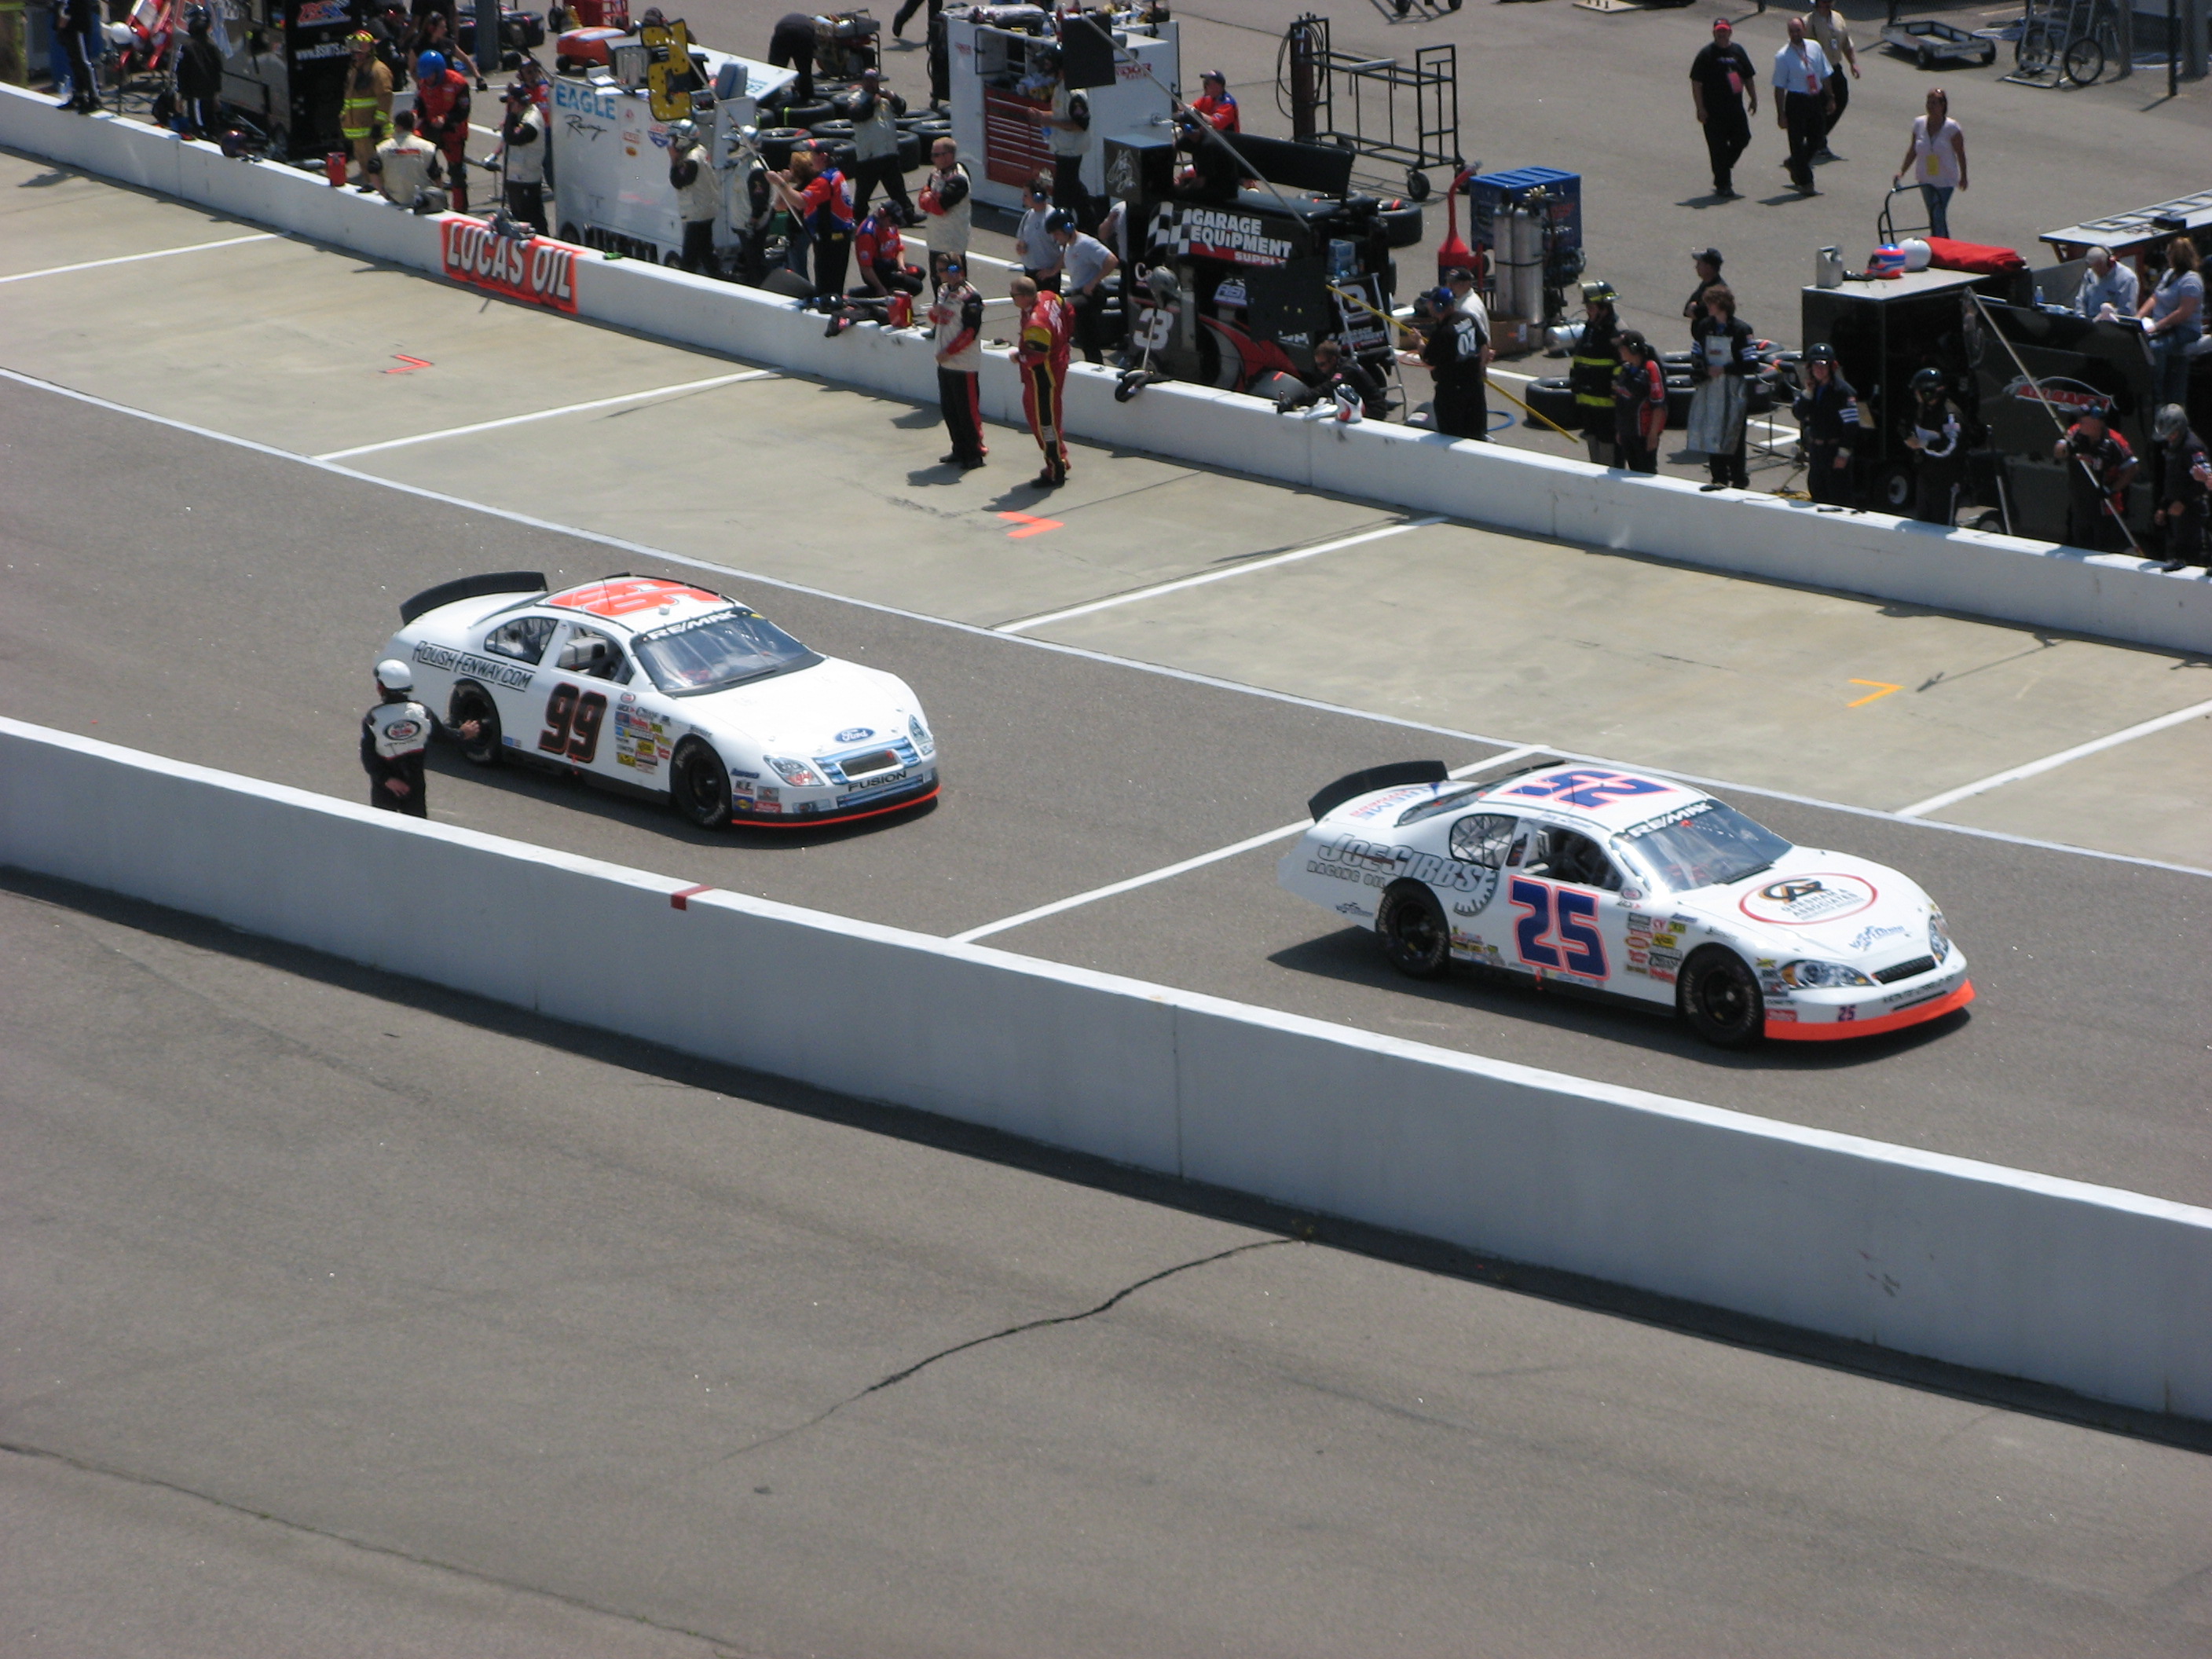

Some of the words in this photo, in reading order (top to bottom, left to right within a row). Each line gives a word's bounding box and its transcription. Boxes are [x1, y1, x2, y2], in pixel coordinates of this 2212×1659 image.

[555, 82, 617, 120] EAGLE
[1192, 207, 1262, 236] GARAGE
[446, 222, 532, 285] LUCAS
[532, 246, 573, 298] OIL
[1133, 308, 1174, 350] 3
[646, 610, 738, 641] RE/MAX
[537, 681, 608, 764] 99
[841, 729, 869, 742] Ford
[848, 771, 906, 792] FUSION
[1628, 802, 1713, 838] RE/MAX
[1307, 859, 1361, 883] RACING
[1508, 874, 1611, 982] 25
[1837, 1005, 1857, 1022] 25
